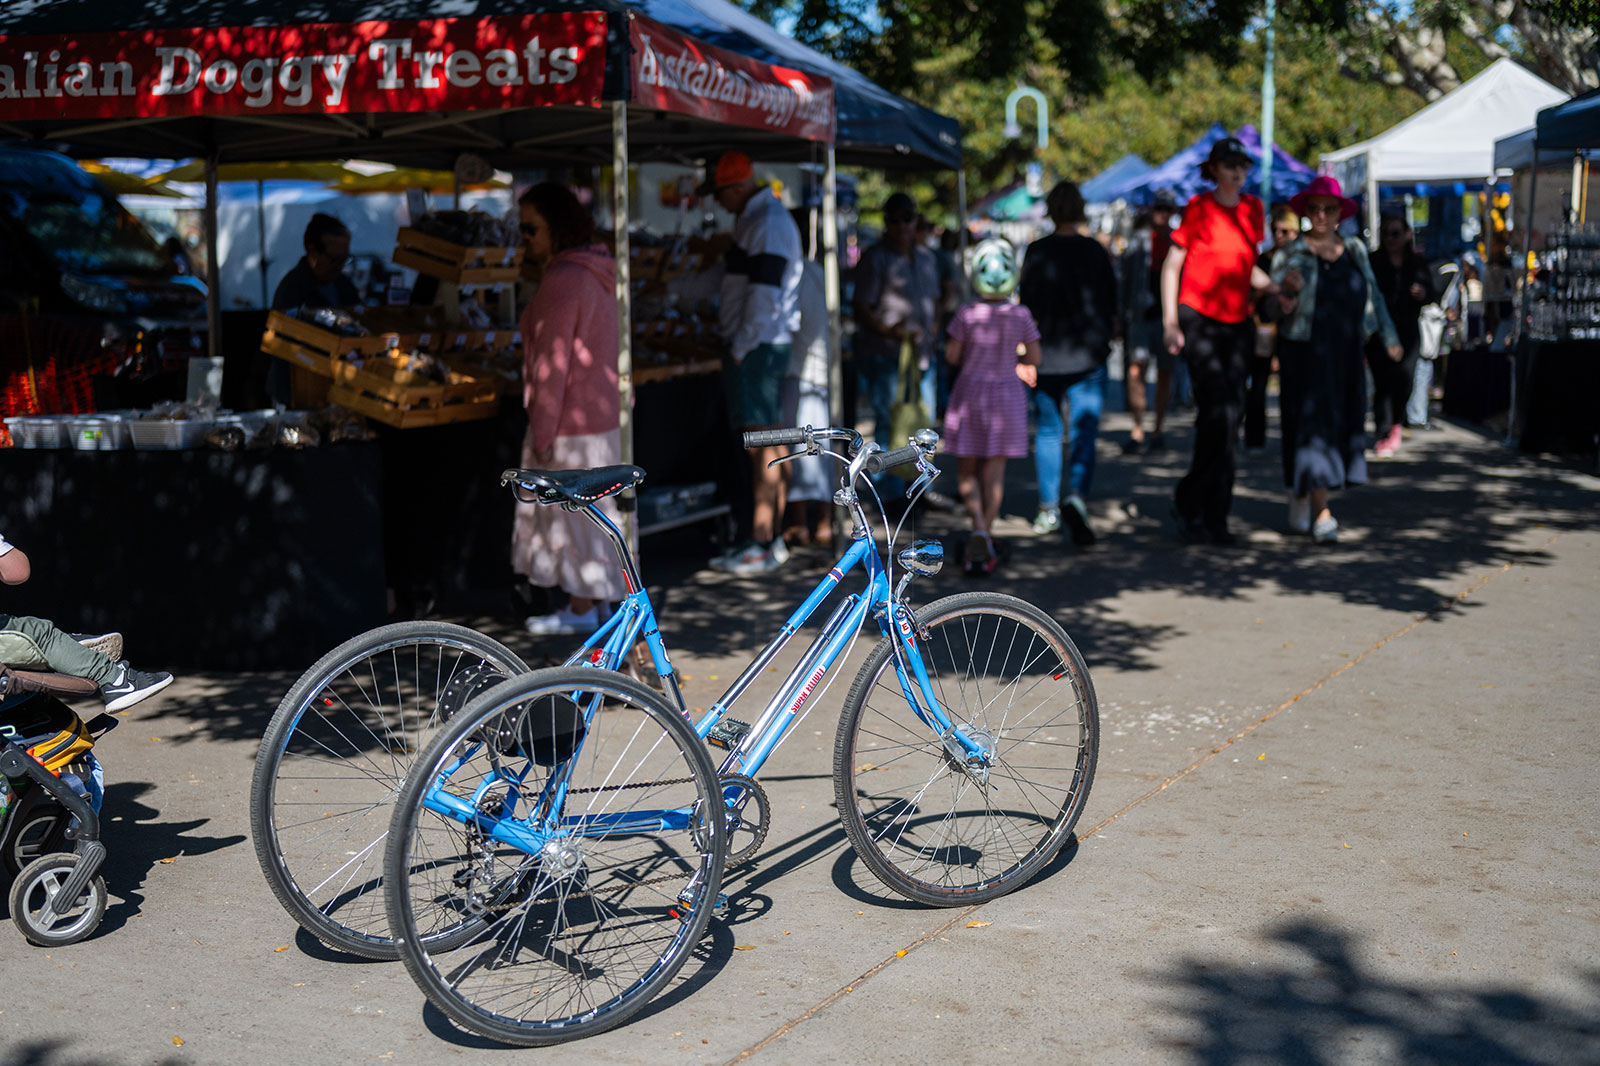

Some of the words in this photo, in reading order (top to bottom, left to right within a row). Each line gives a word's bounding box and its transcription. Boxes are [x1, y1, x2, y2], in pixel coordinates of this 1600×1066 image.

[152, 47, 356, 107] Doggy
[369, 35, 578, 89] Treats
[901, 622, 909, 631] E
